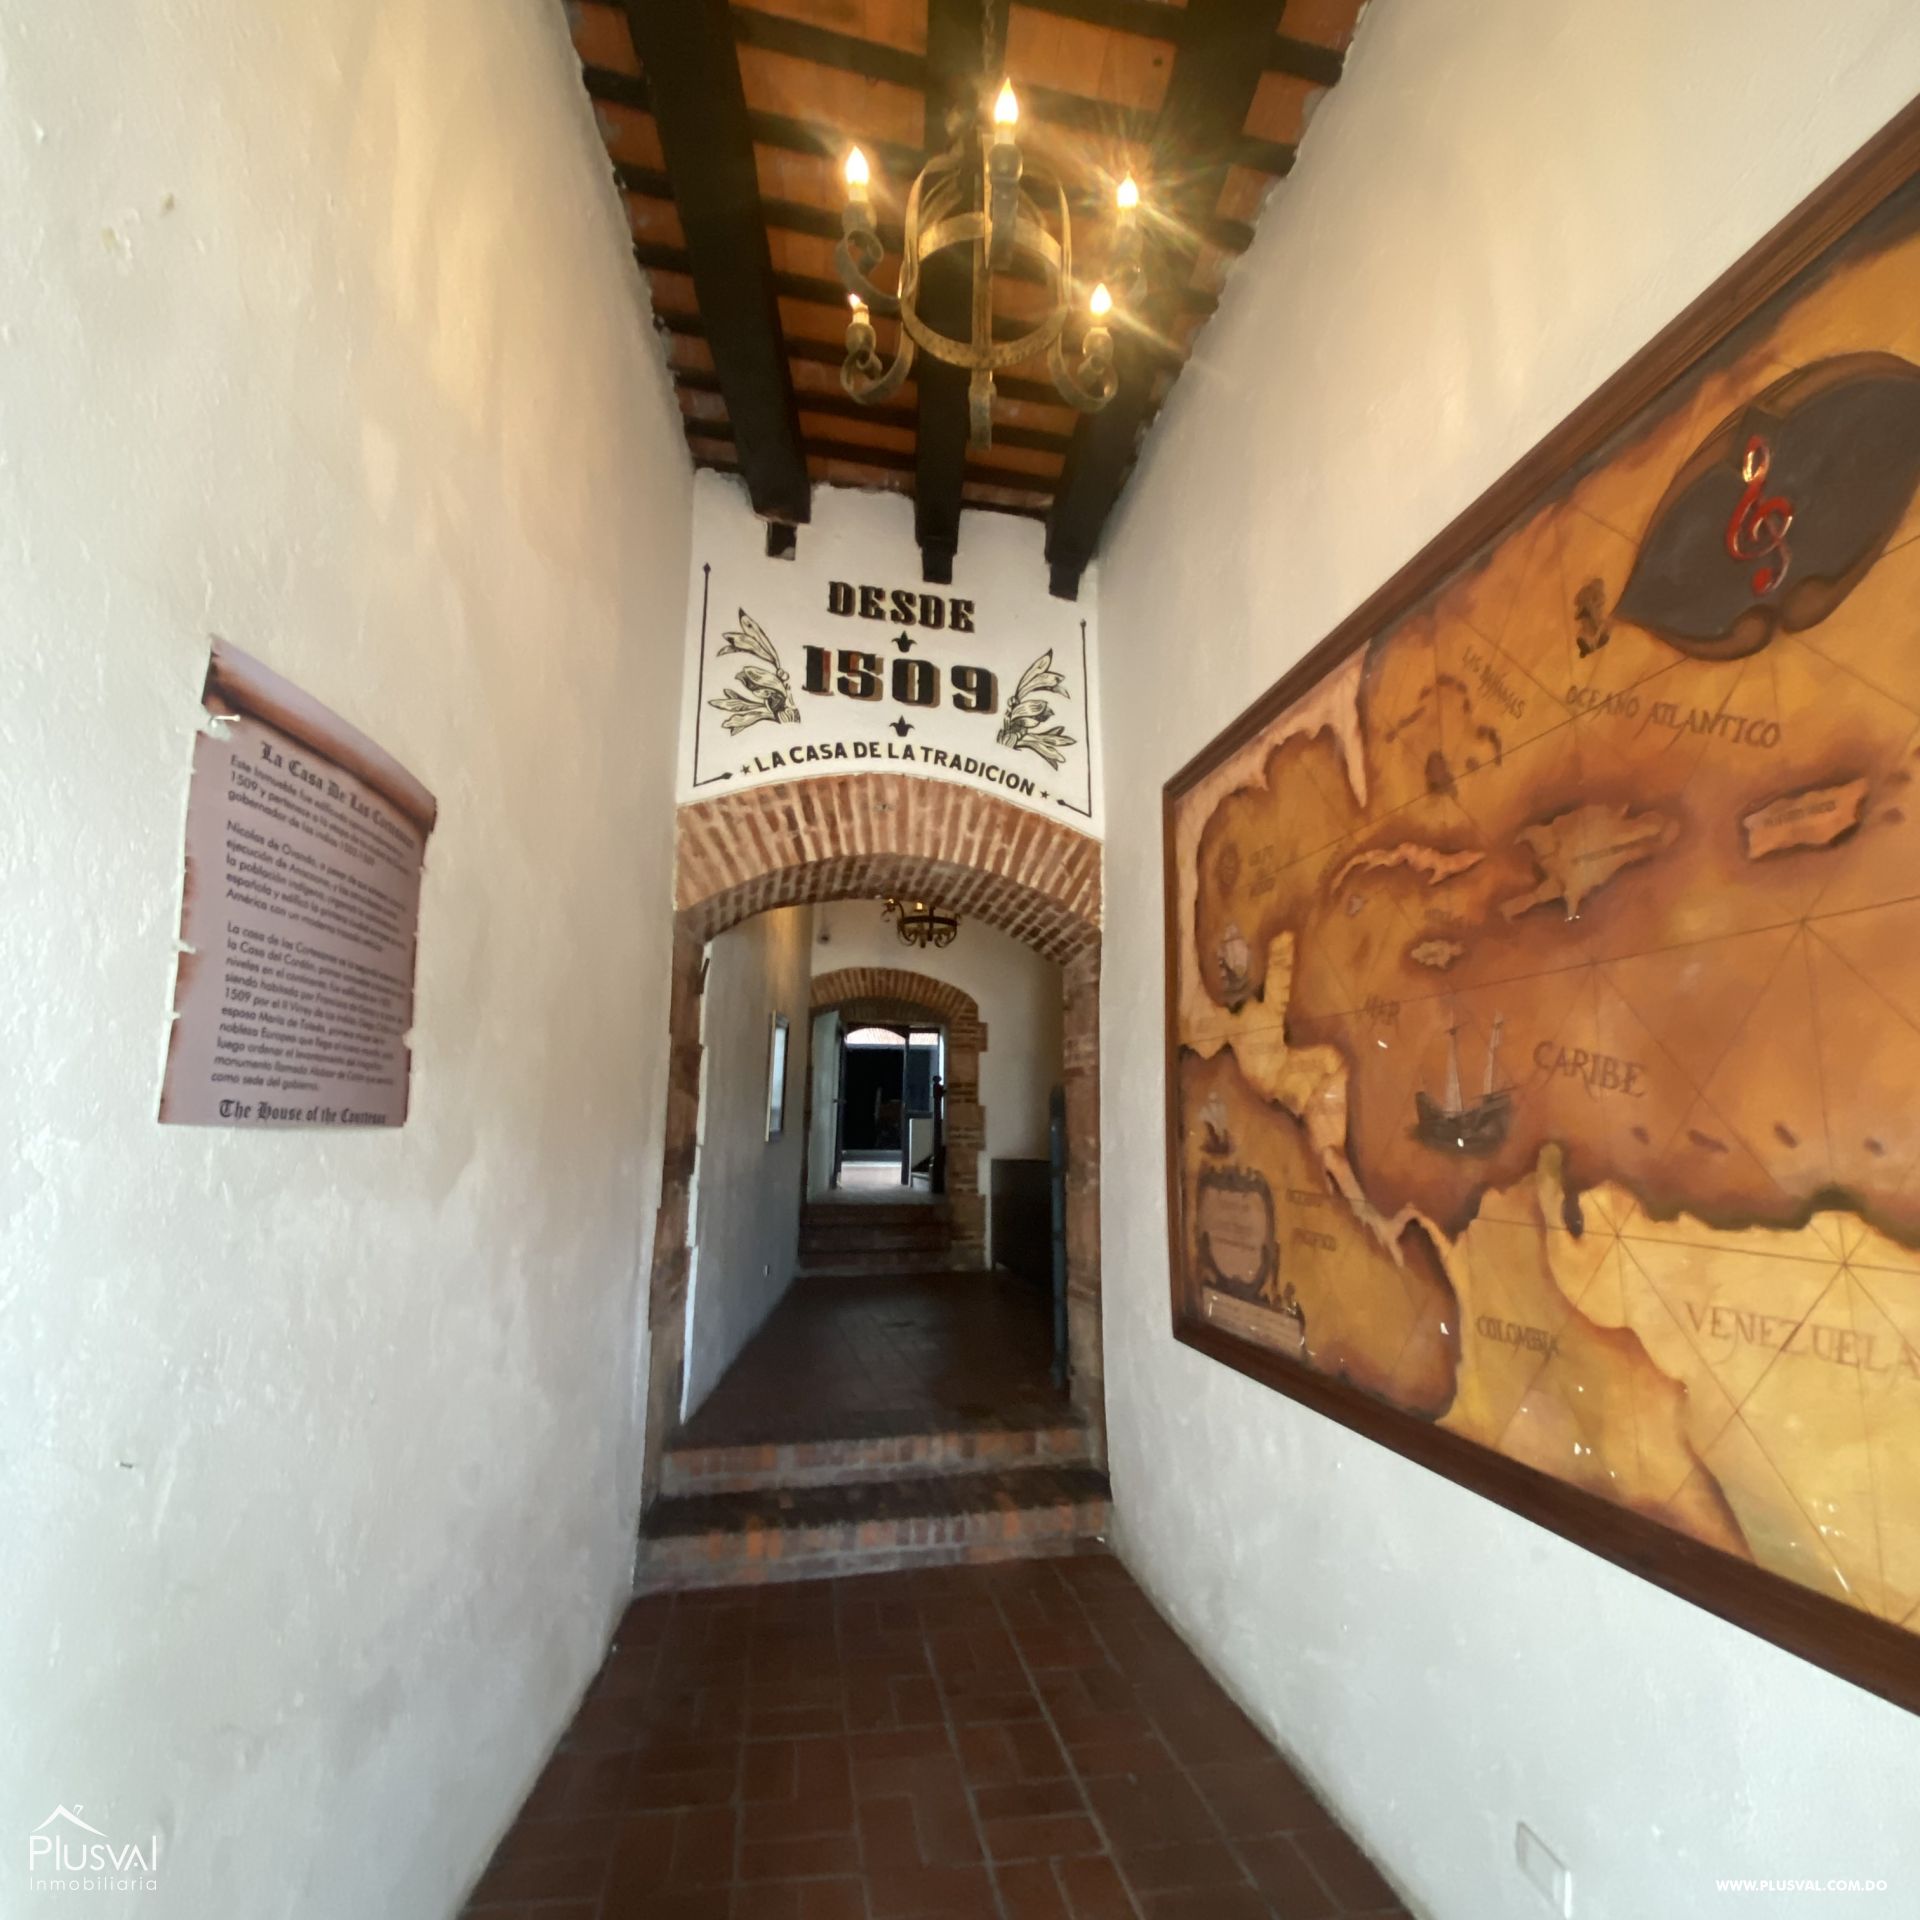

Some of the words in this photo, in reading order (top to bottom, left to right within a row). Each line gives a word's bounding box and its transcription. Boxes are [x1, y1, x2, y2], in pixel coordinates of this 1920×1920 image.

[827, 581, 976, 633] DESDE
[802, 645, 999, 714] 1509
[1566, 685, 1640, 719] OCEANO
[1650, 701, 1781, 748] ATLANTICO
[261, 741, 282, 768] La
[289, 760, 323, 790] Casa
[754, 751, 786, 772] LA
[789, 742, 848, 764] CASA
[853, 741, 882, 759] DE
[887, 742, 915, 761] LA
[920, 746, 1035, 797] TRADICION
[226, 852, 237, 867] la
[267, 837, 280, 852] de
[227, 921, 240, 935] La
[267, 934, 279, 947] de
[227, 937, 237, 951] la
[240, 941, 265, 958] Casa
[1533, 1040, 1649, 1101] CARIBE
[220, 1099, 252, 1119] The
[257, 1101, 303, 1121] House
[306, 1106, 319, 1122] of
